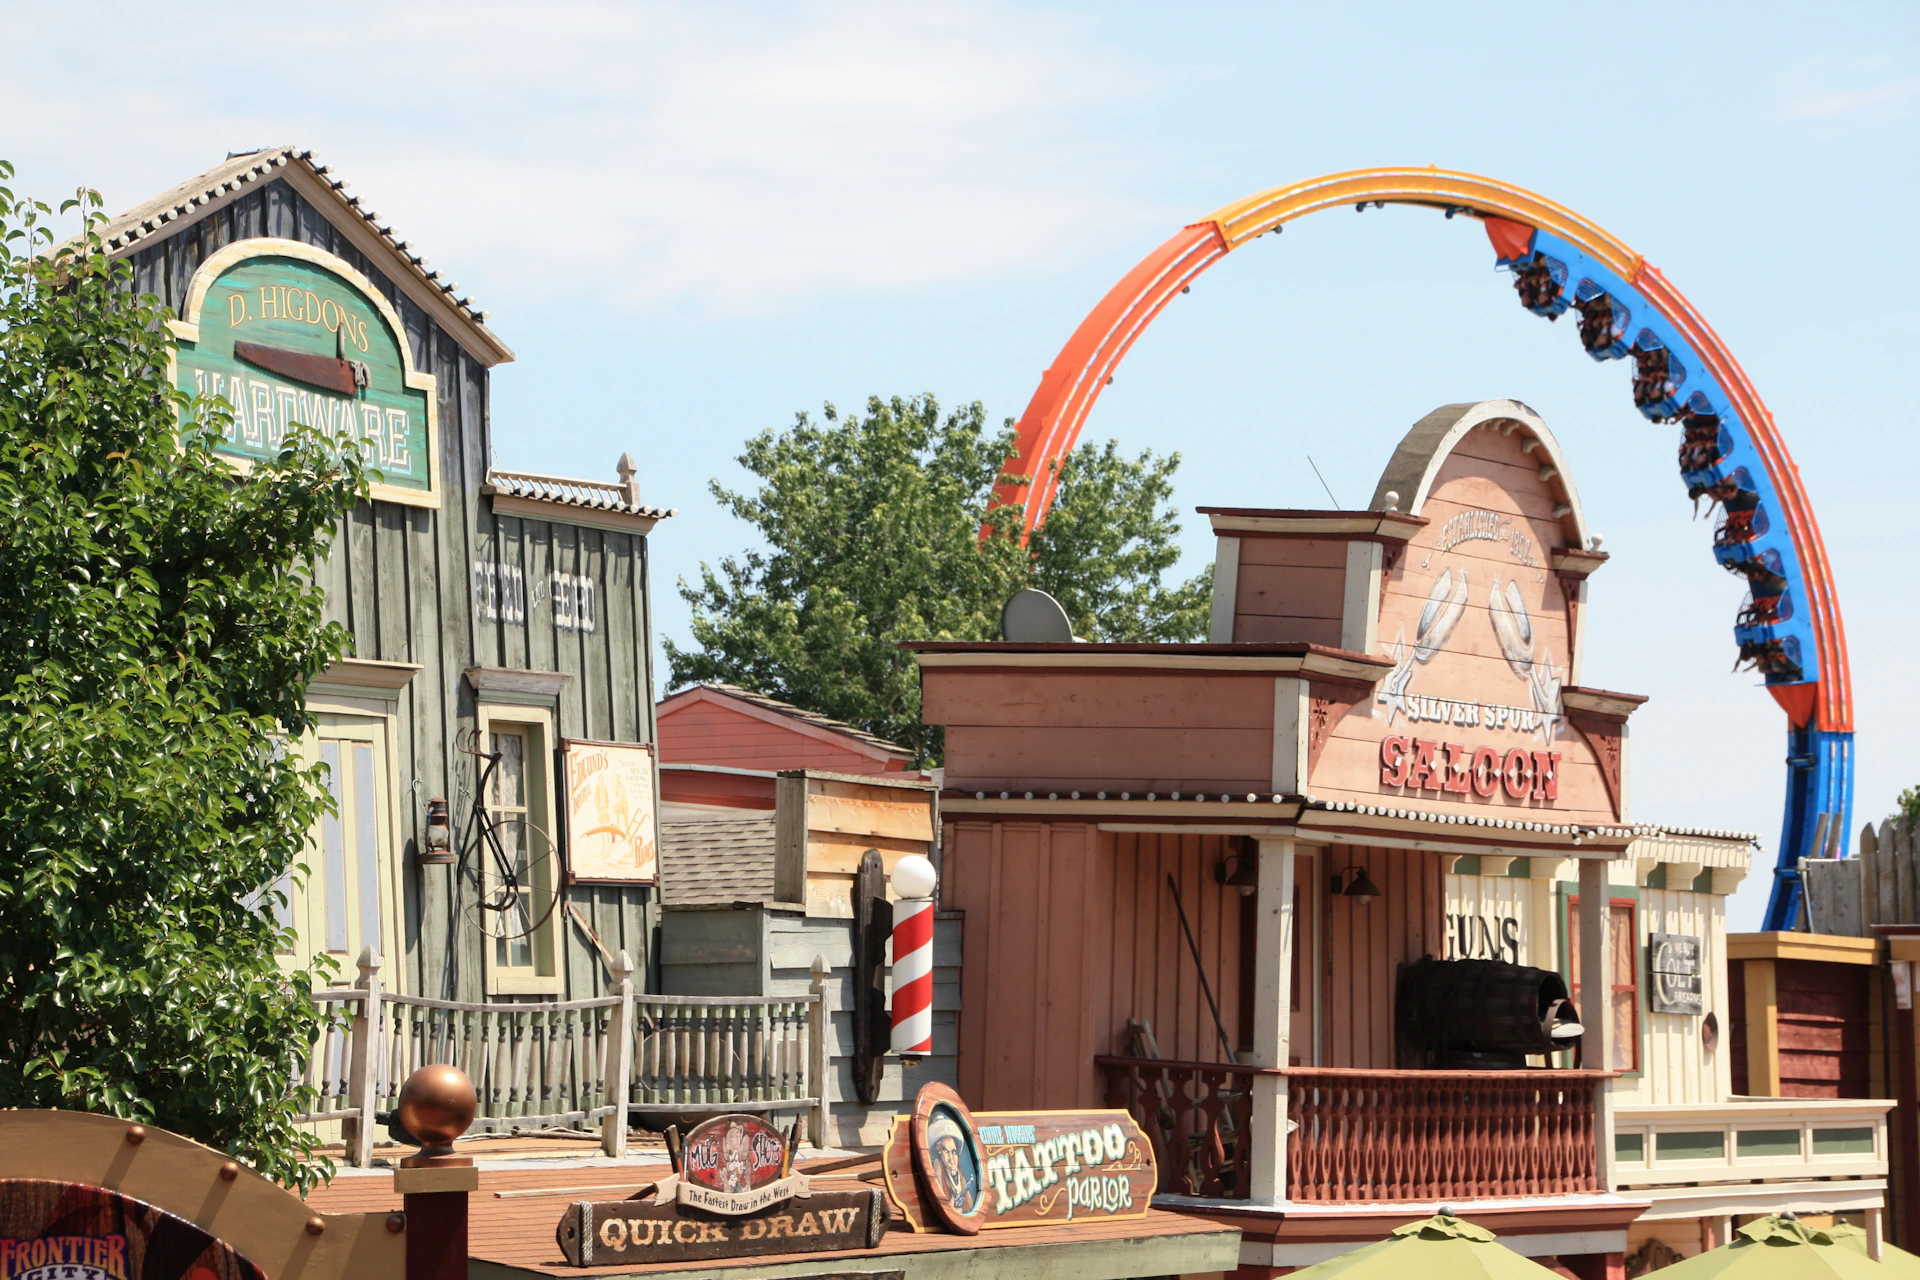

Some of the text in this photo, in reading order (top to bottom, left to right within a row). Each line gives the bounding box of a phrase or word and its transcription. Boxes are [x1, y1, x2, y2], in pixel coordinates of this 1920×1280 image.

[228, 285, 369, 353] D. HIGDONS
[194, 369, 412, 475] HARDWARE
[1440, 510, 1500, 556] ESTABLISHED
[474, 561, 524, 622] FEED
[549, 570, 595, 633] SEED
[1406, 694, 1536, 733] SILVER SPUR
[1381, 734, 1561, 802] SALOON
[1656, 942, 1696, 1005] COLT
[1674, 991, 1702, 1006] FIREARMS
[690, 1131, 782, 1171] MUG SHOTS
[987, 1123, 1128, 1215] TATTOO
[689, 1186, 790, 1212] The Fastest Draw in the West
[599, 1206, 861, 1252] QUICK DRAW
[0, 1234, 128, 1280] FRONTIER
